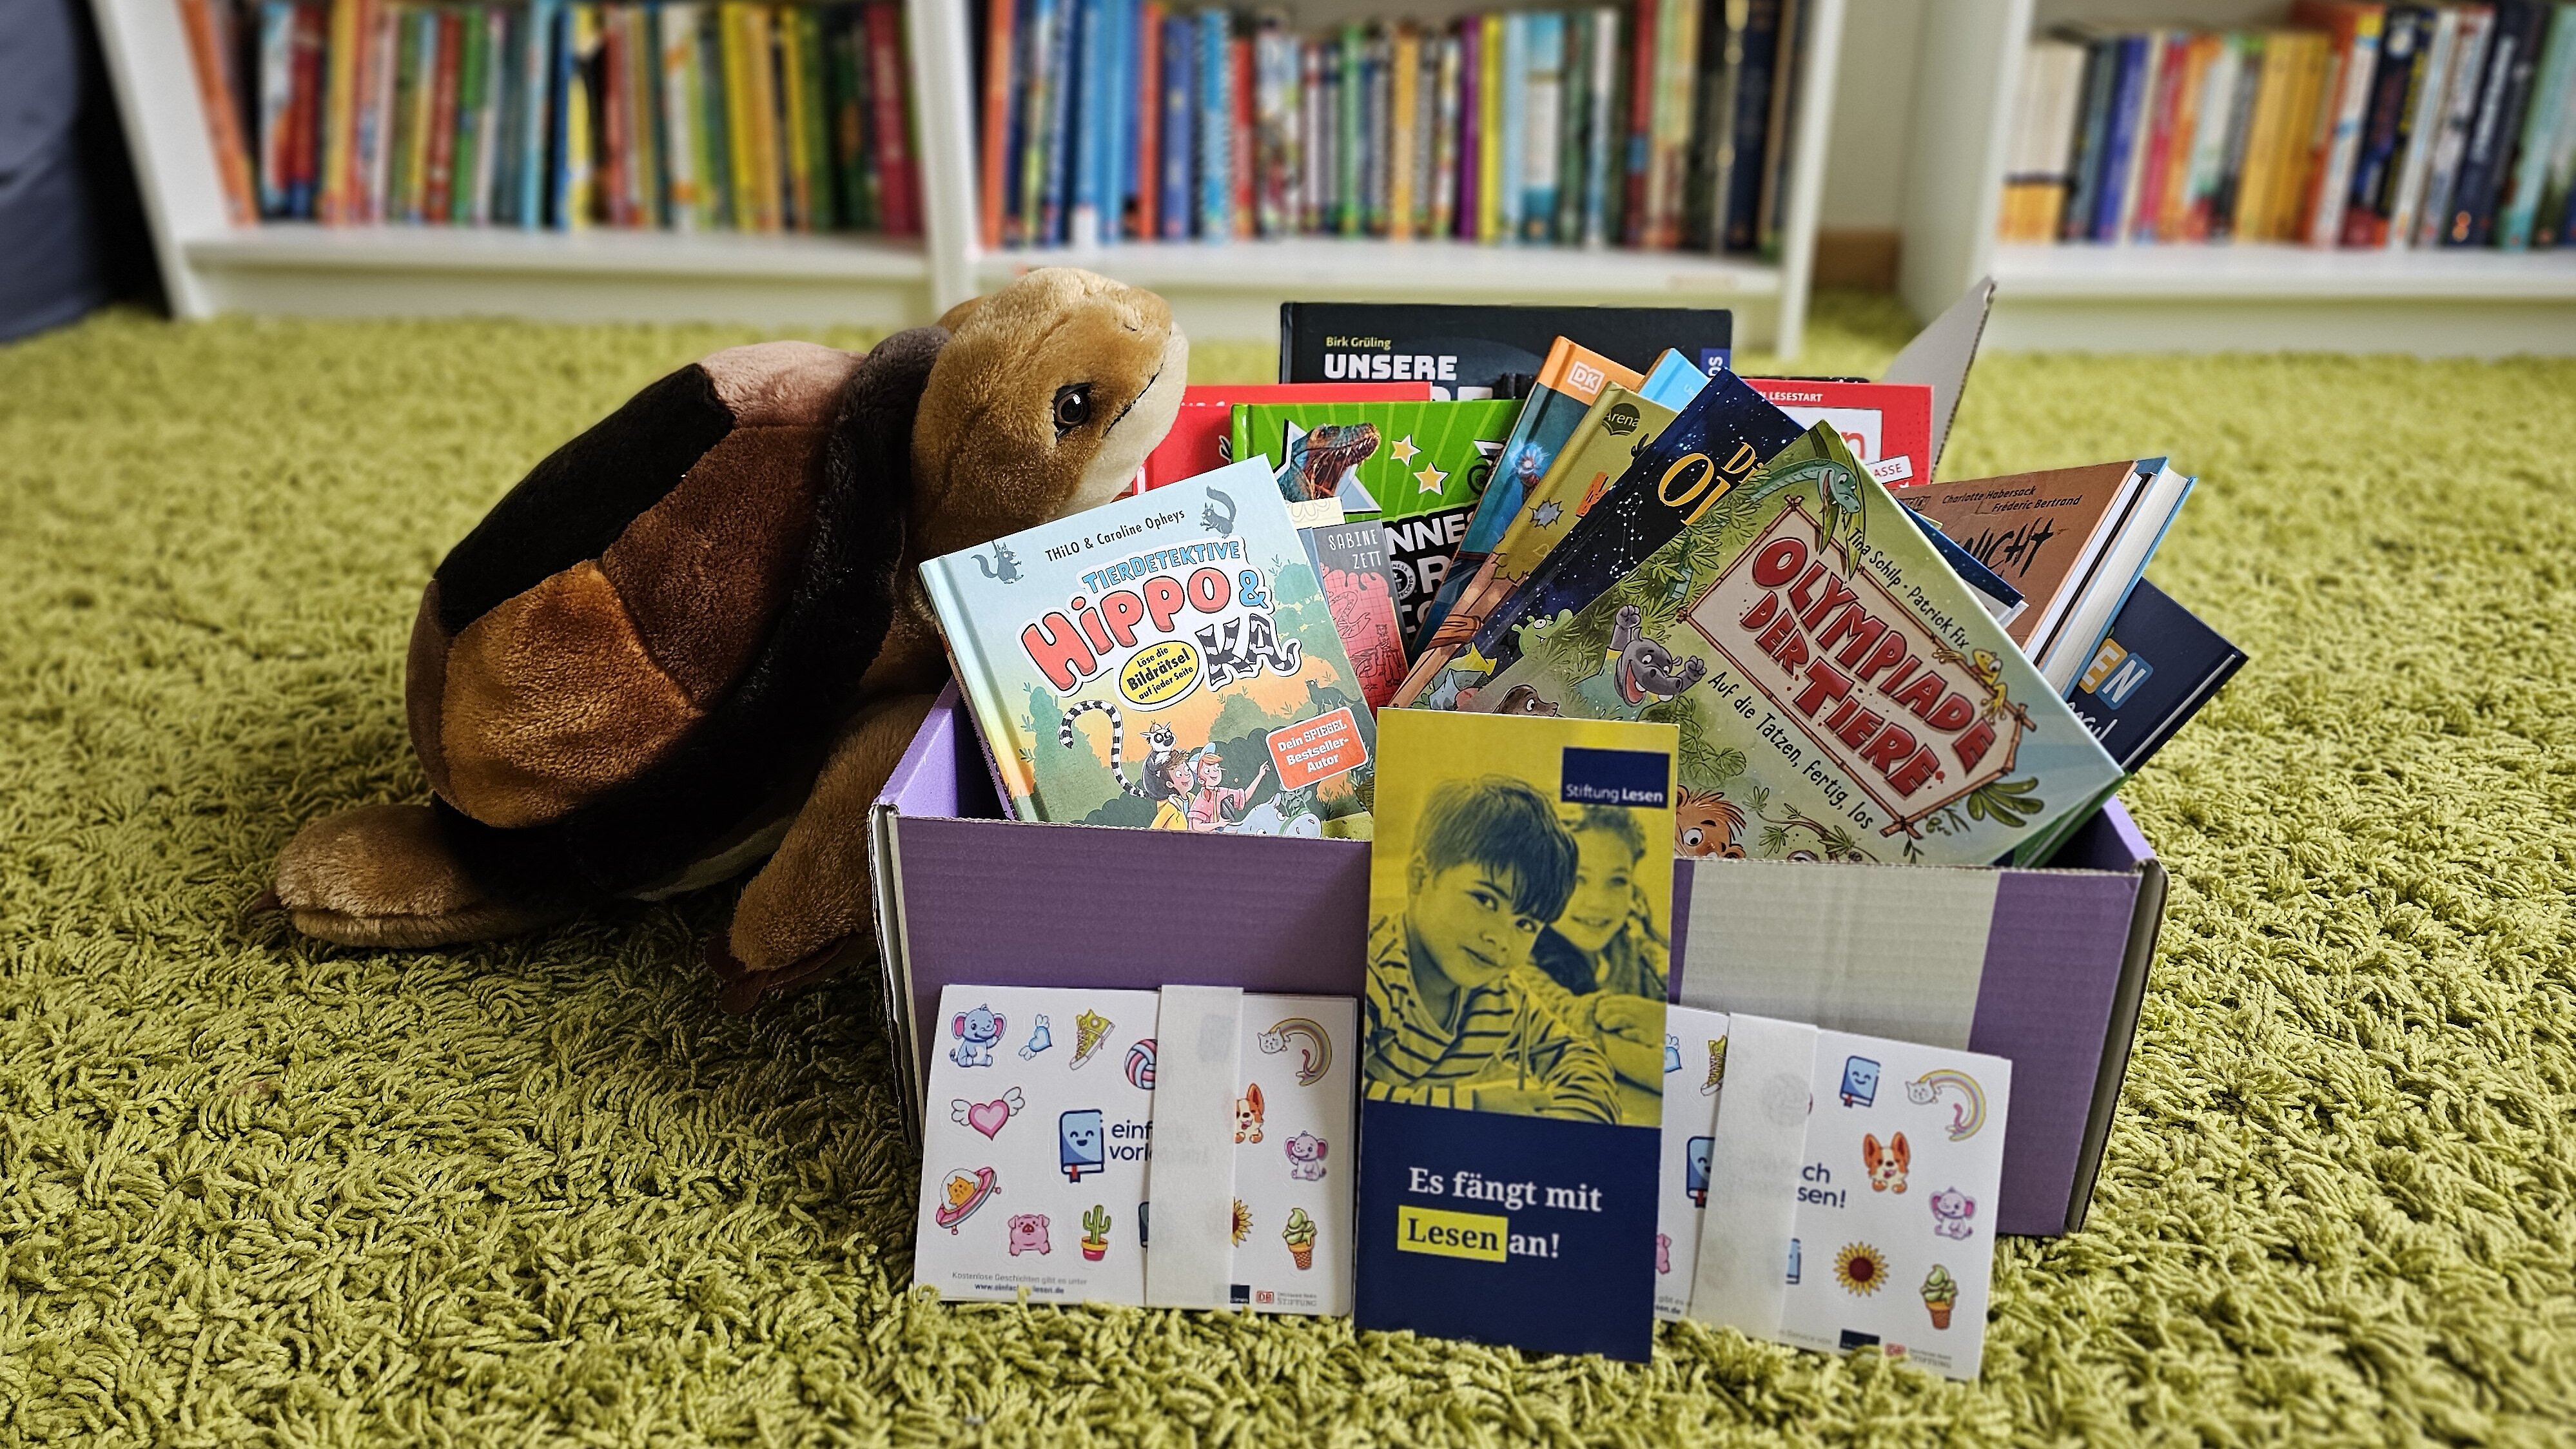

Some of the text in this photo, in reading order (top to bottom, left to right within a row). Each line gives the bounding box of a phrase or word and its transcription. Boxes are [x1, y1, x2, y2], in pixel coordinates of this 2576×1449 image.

[1326, 336, 1391, 350] Birk Grüling
[1324, 353, 1458, 381] UNSERE
[1573, 367, 1599, 389] DK
[1769, 392, 1823, 402] LESESTART
[1605, 410, 1639, 427] Arena
[1942, 492, 1984, 503] Charlotte
[1986, 485, 2036, 500] Habersack
[2034, 495, 2082, 509] Bertrand
[1045, 509, 1186, 561] THiLO & Caroline Opheys
[1328, 529, 1378, 550] SABINE
[1082, 541, 1240, 594] TIERDETEKTIVE
[1352, 550, 1381, 569] ZETT
[1239, 570, 1268, 609] &
[1848, 527, 1969, 649] Tina Schilp Patrick Fix
[1127, 648, 1190, 690] Bildrätsel
[1137, 648, 1169, 667] Löse die
[1752, 537, 1996, 775] OLYMPIADE
[1138, 666, 1194, 699] auf jeder Seite
[1740, 590, 1941, 798] DER TIERE
[1277, 719, 1347, 752] Dein SPIEGEL
[1285, 737, 1349, 766] Bestseller-
[1307, 754, 1339, 773] Autor
[1708, 671, 1739, 698] Auf
[1733, 696, 1755, 719] die
[1756, 712, 1802, 768] Tatzen,
[1847, 801, 1873, 830] los
[1566, 784, 1663, 803] Stiftung Lesen
[1109, 1143, 1151, 1162] vorl
[1409, 1167, 1603, 1212] Es fängt mit
[1407, 1217, 1560, 1258] Lesen an!
[952, 1272, 993, 1281] Kostenlose
[995, 1274, 1040, 1283] Geschichten
